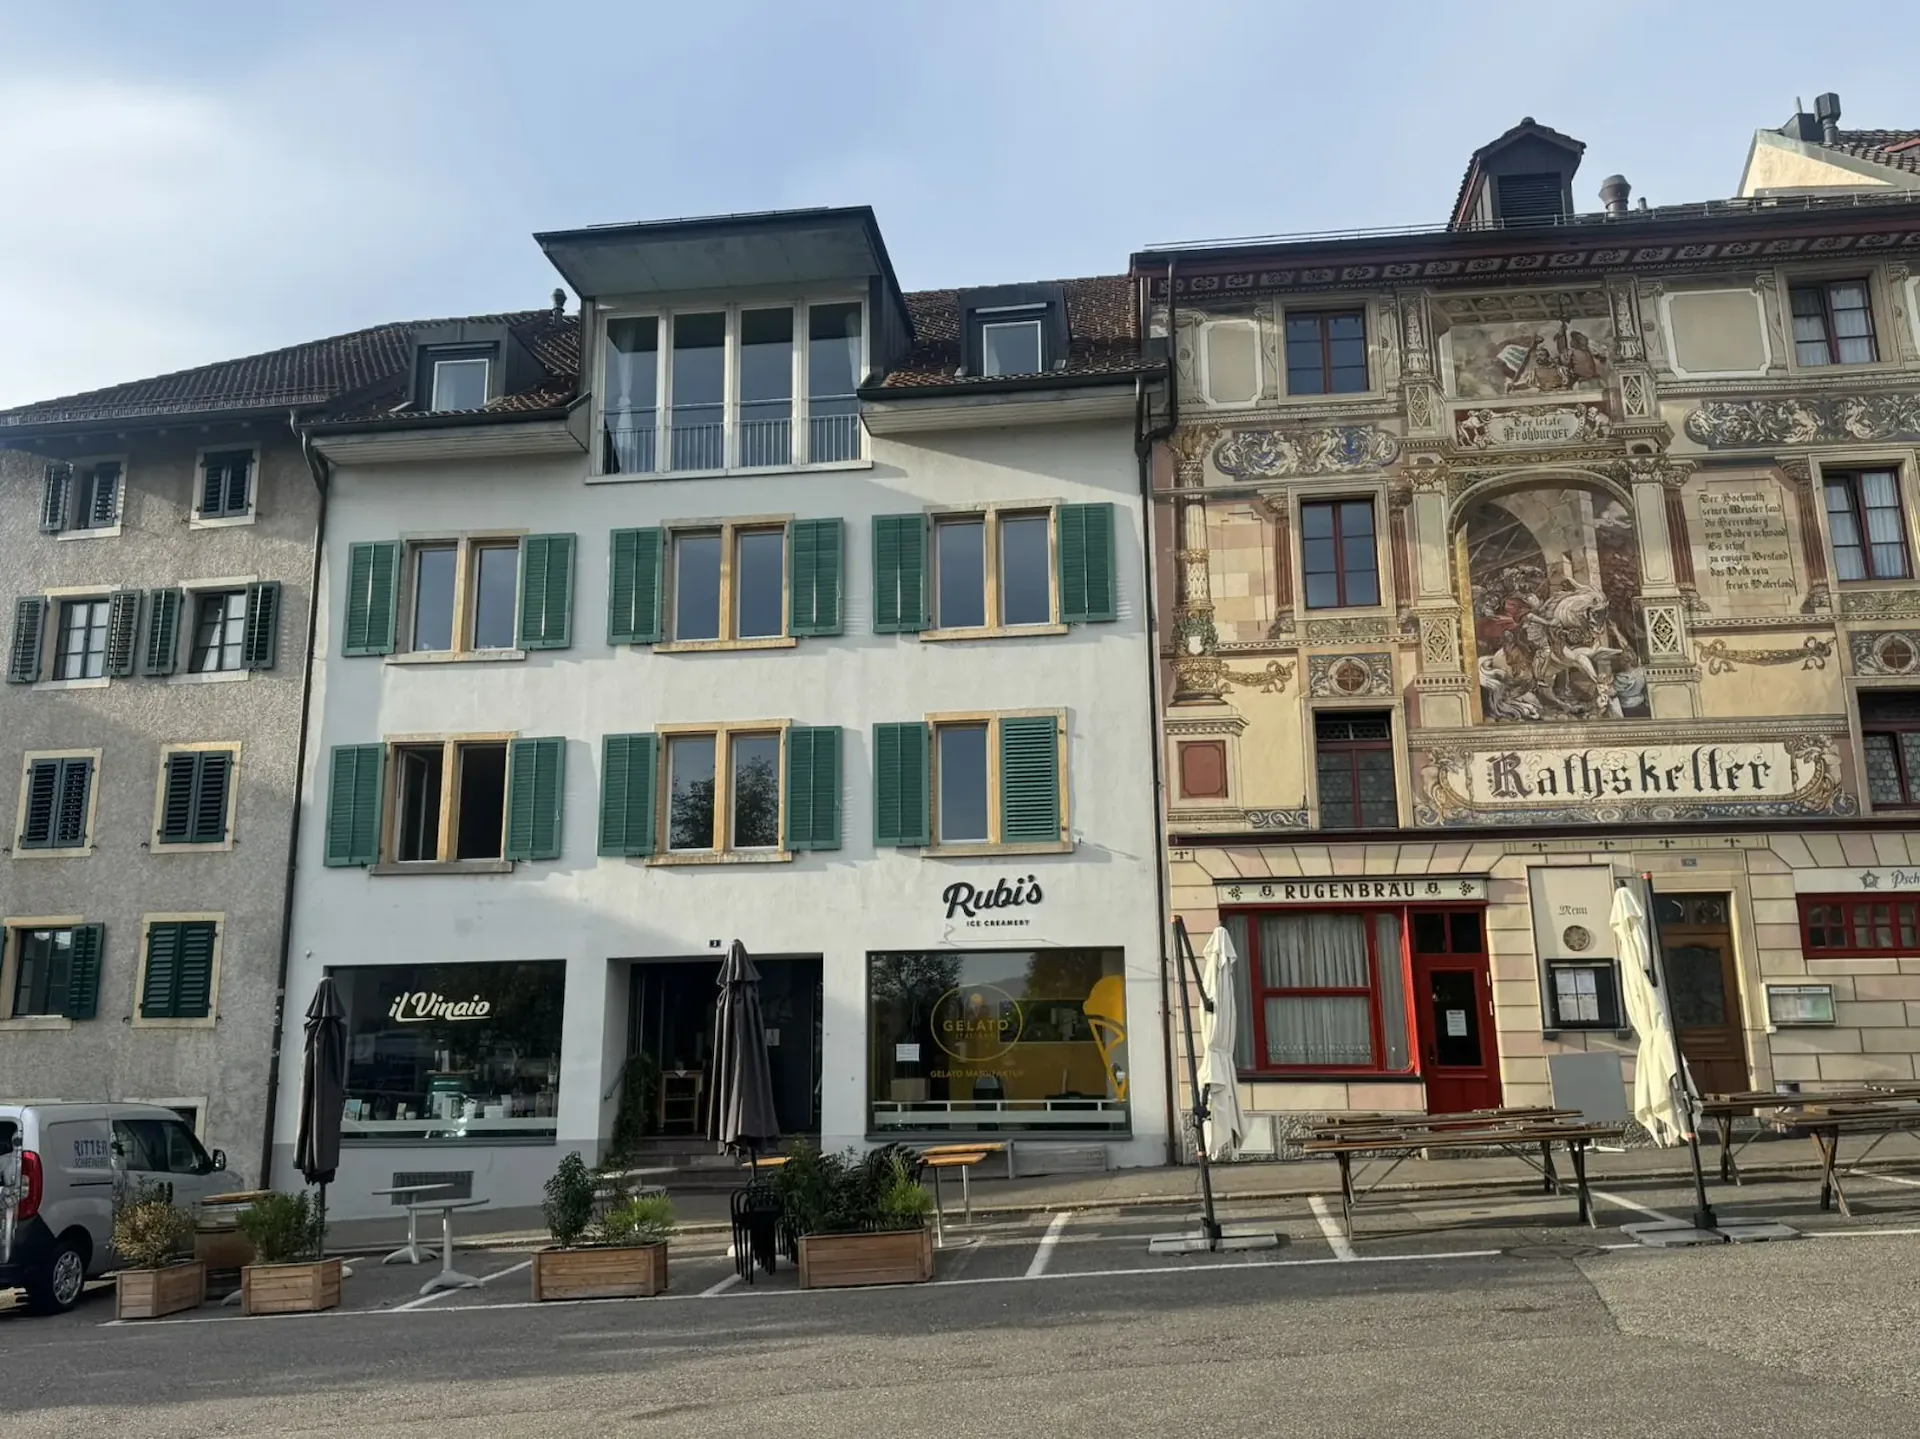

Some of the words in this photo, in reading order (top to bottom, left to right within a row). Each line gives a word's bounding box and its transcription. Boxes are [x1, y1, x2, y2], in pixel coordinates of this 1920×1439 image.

[1729, 504, 1763, 514] Meister
[1486, 746, 1772, 800] Rathskeller
[942, 874, 1043, 919] Rubi's
[1284, 881, 1416, 900] RUGENBRÄU
[1558, 904, 1588, 916] Menu
[966, 920, 981, 928] ICE
[983, 919, 1030, 927] CREAMERY
[410, 991, 492, 1022] Vinaio
[942, 1019, 1009, 1032] GELATO
[930, 1069, 965, 1078] GELATO
[73, 1139, 108, 1157] RITTER
